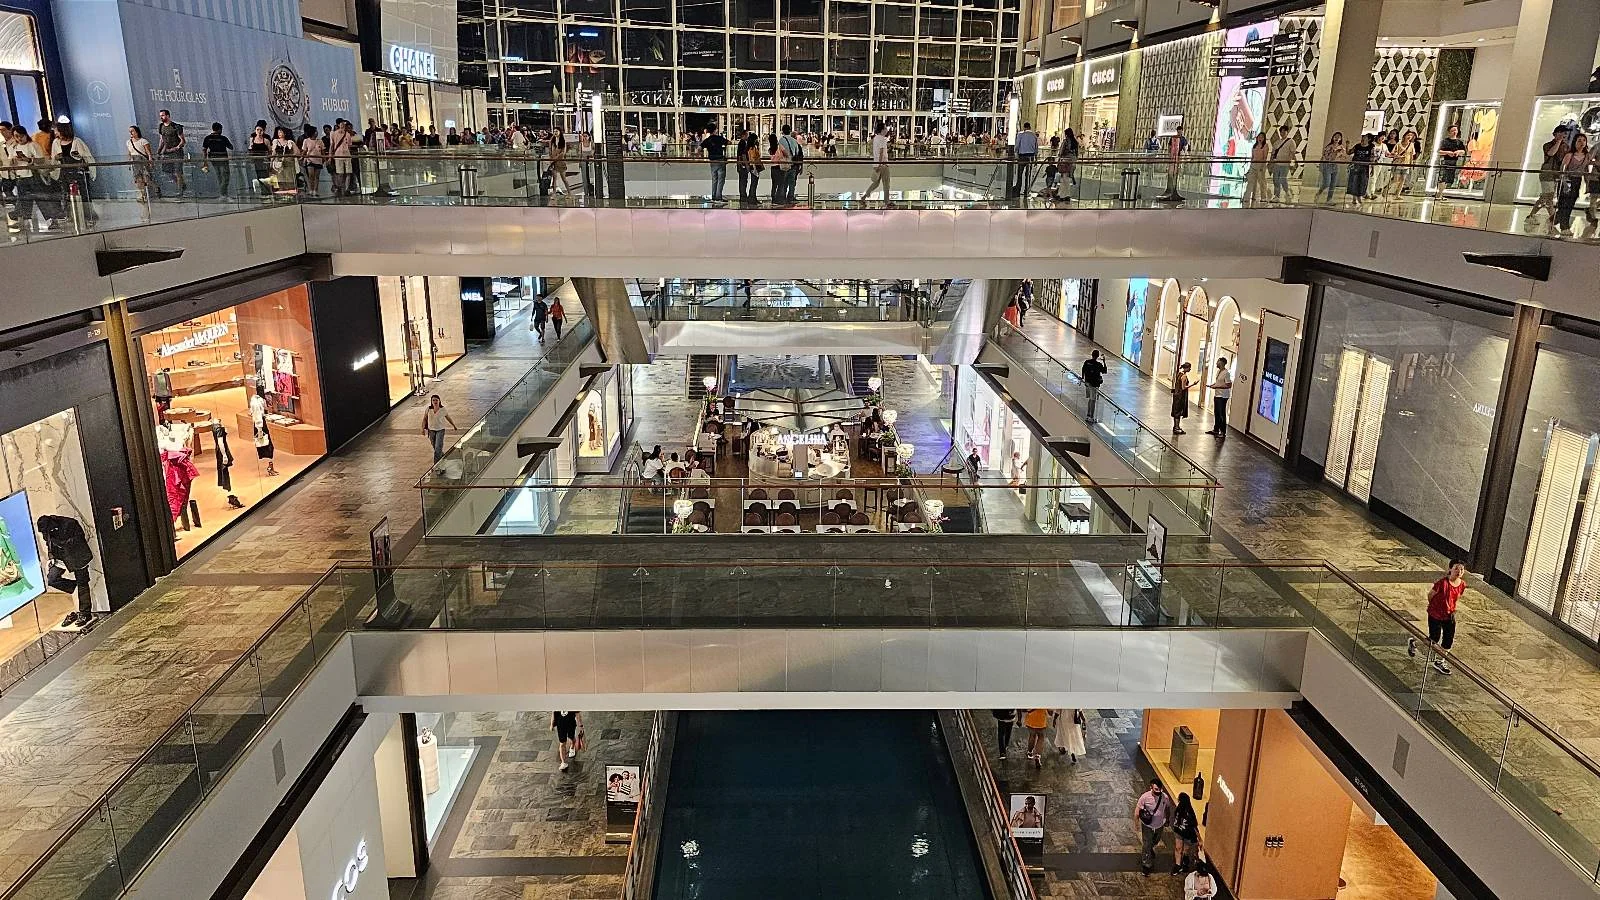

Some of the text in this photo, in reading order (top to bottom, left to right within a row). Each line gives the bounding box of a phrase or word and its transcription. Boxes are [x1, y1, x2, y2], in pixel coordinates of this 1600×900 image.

[390, 45, 438, 80] CHANEL
[1047, 77, 1065, 92] GUCCI
[1091, 67, 1115, 86] GUCCI
[150, 88, 207, 104] THE HOUR GLASS
[321, 97, 350, 112] HUBLOT
[777, 433, 827, 445] ANGELINA
[1216, 774, 1235, 805] Aesop
